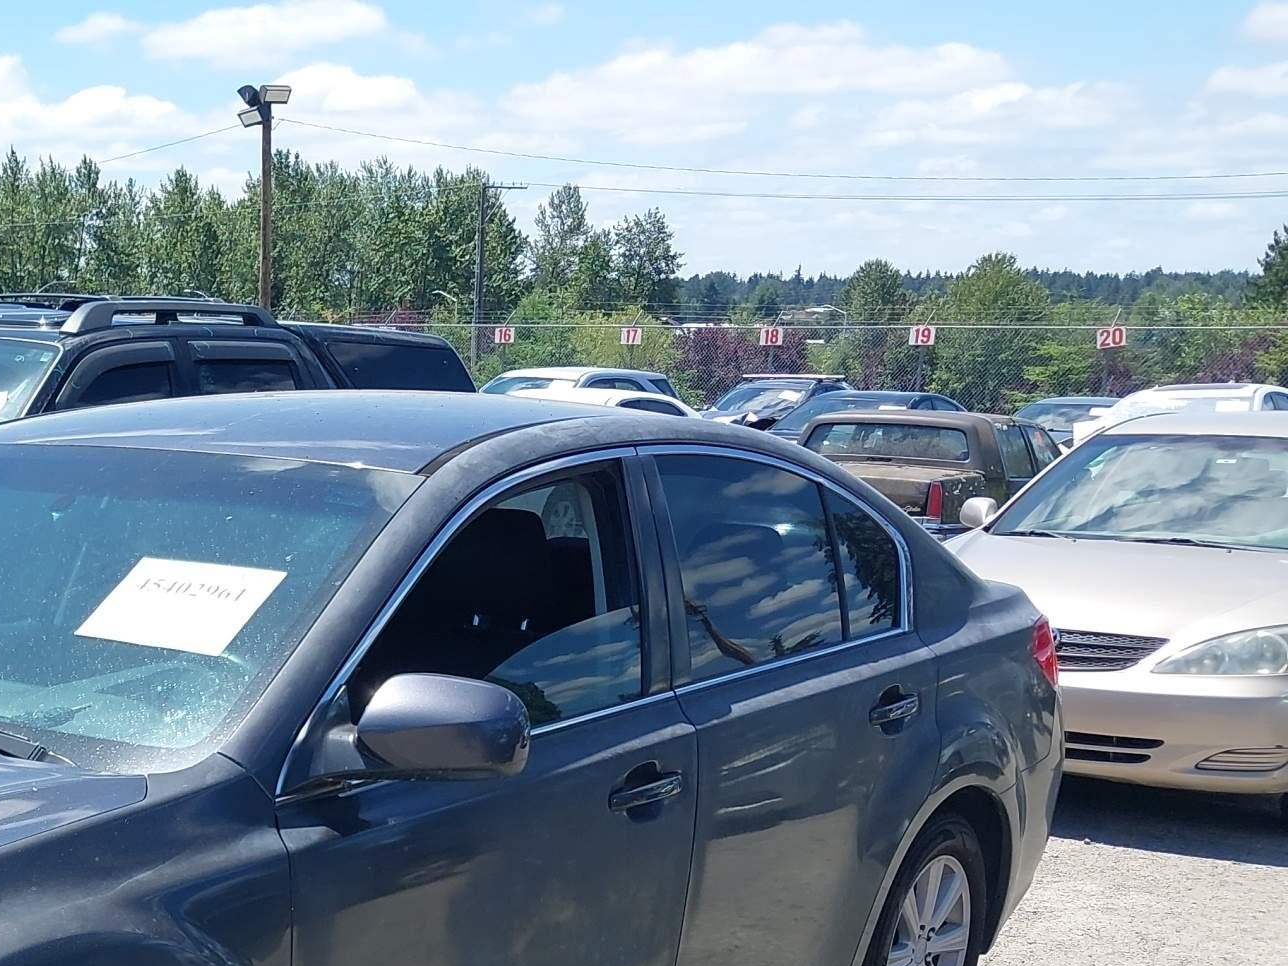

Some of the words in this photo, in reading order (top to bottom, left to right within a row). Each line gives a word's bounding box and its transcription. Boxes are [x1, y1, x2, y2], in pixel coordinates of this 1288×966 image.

[497, 327, 512, 342] 16
[625, 329, 638, 343] 17
[764, 328, 780, 344] 18
[914, 327, 932, 344] 19
[1099, 327, 1123, 347] 20
